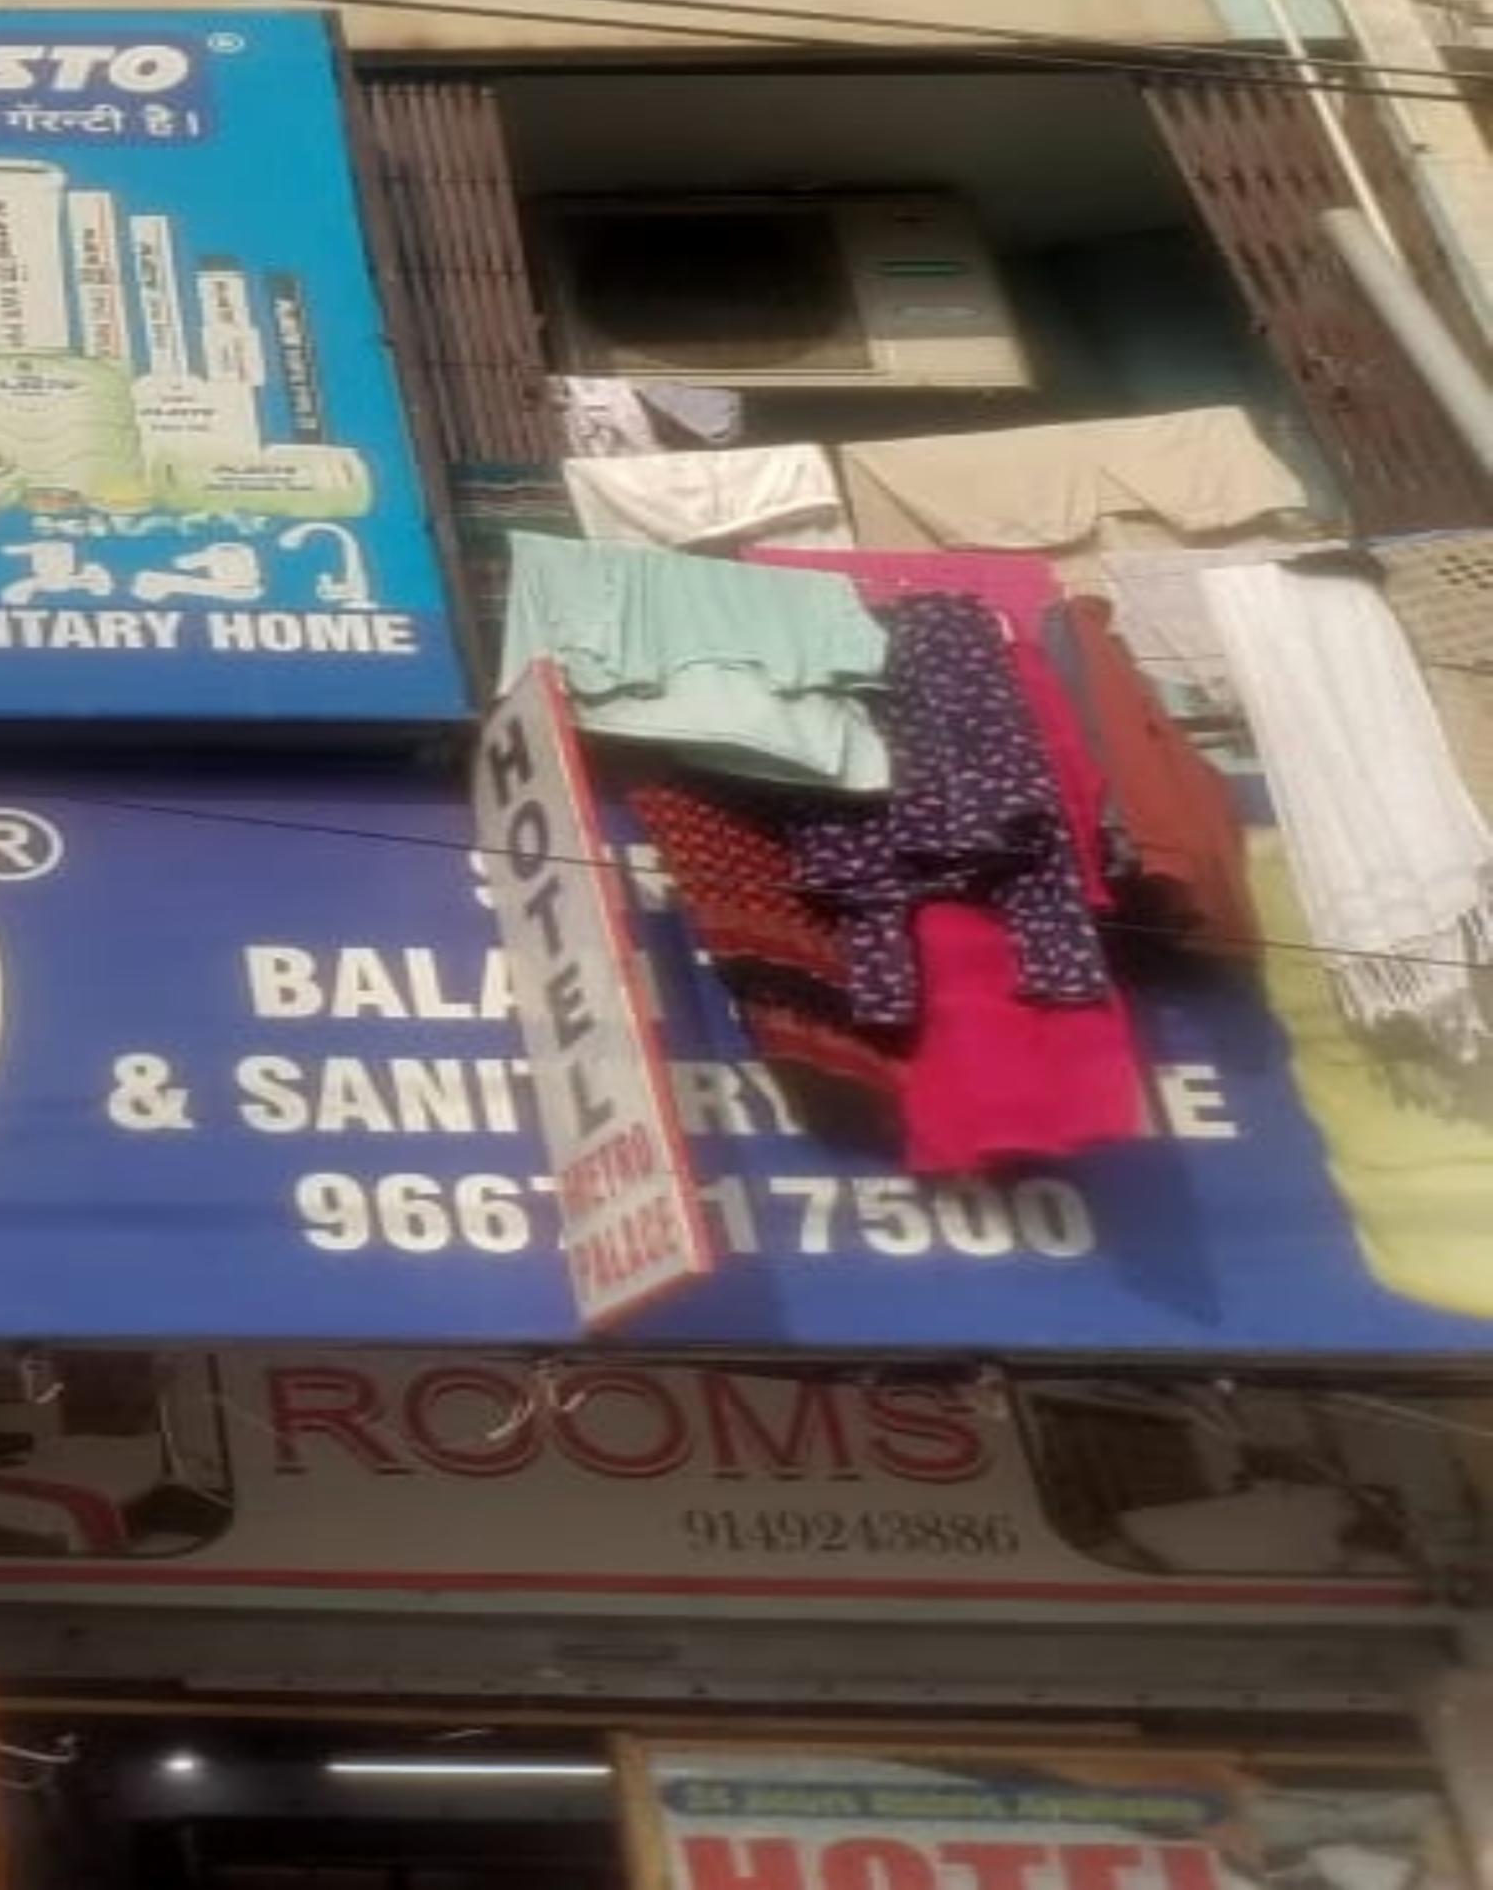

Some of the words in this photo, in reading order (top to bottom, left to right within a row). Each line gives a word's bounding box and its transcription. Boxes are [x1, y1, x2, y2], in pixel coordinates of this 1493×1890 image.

[207, 612, 418, 653] HOME
[483, 714, 615, 1142] HOTEL
[108, 1053, 194, 1130] &
[234, 1053, 807, 1135] SANIRY
[296, 1172, 1097, 1257] 96617500
[266, 1366, 988, 1486] ROOMS
[679, 1506, 1019, 1556] 9149243886
